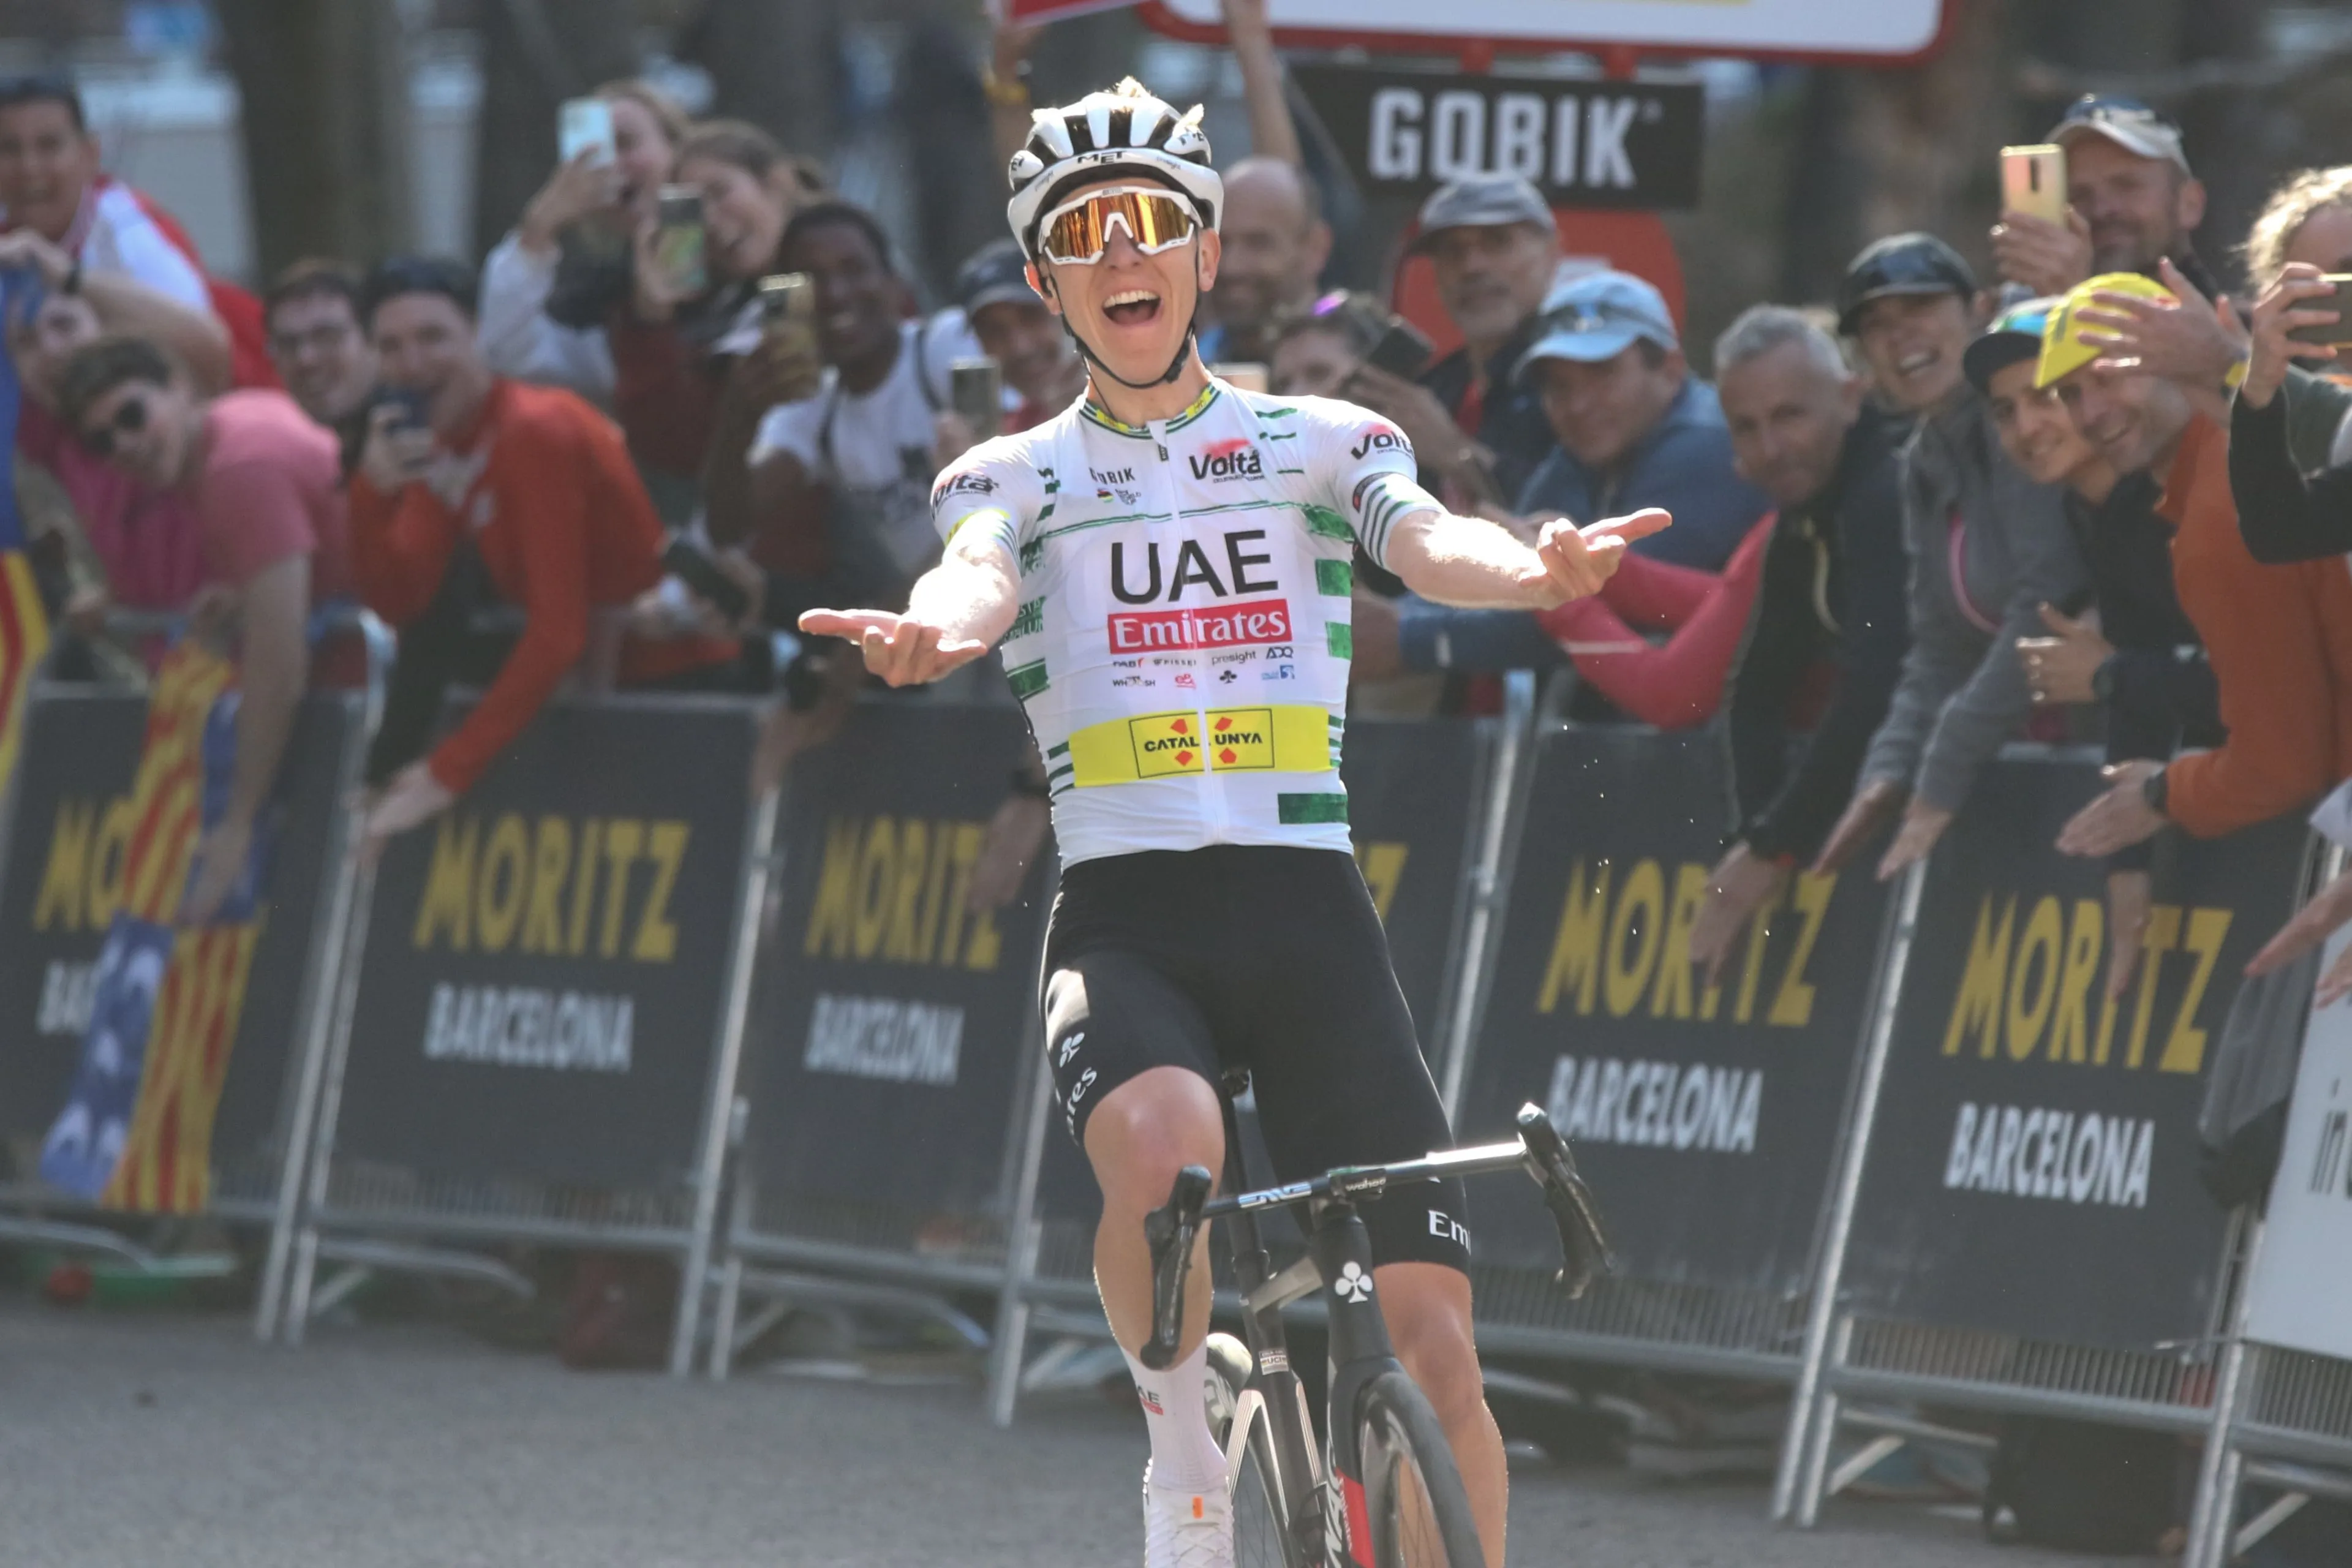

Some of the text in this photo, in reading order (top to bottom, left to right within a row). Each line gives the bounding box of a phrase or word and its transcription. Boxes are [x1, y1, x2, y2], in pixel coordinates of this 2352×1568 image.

[1077, 151, 1126, 165] MET
[1369, 87, 1637, 188] GOBIK
[1111, 529, 1278, 605] UAE
[1114, 606, 1286, 648] Emirates
[32, 795, 131, 932] MO
[412, 812, 691, 963] MORITZ
[424, 984, 634, 1073] BARCELONA
[804, 993, 965, 1085] BARCELONA
[1545, 1052, 1763, 1153] BARCELONA
[1346, 1178, 1386, 1191] wahoo
[1943, 1101, 2155, 1208] BARCELONA
[1428, 1210, 1471, 1256] Em
